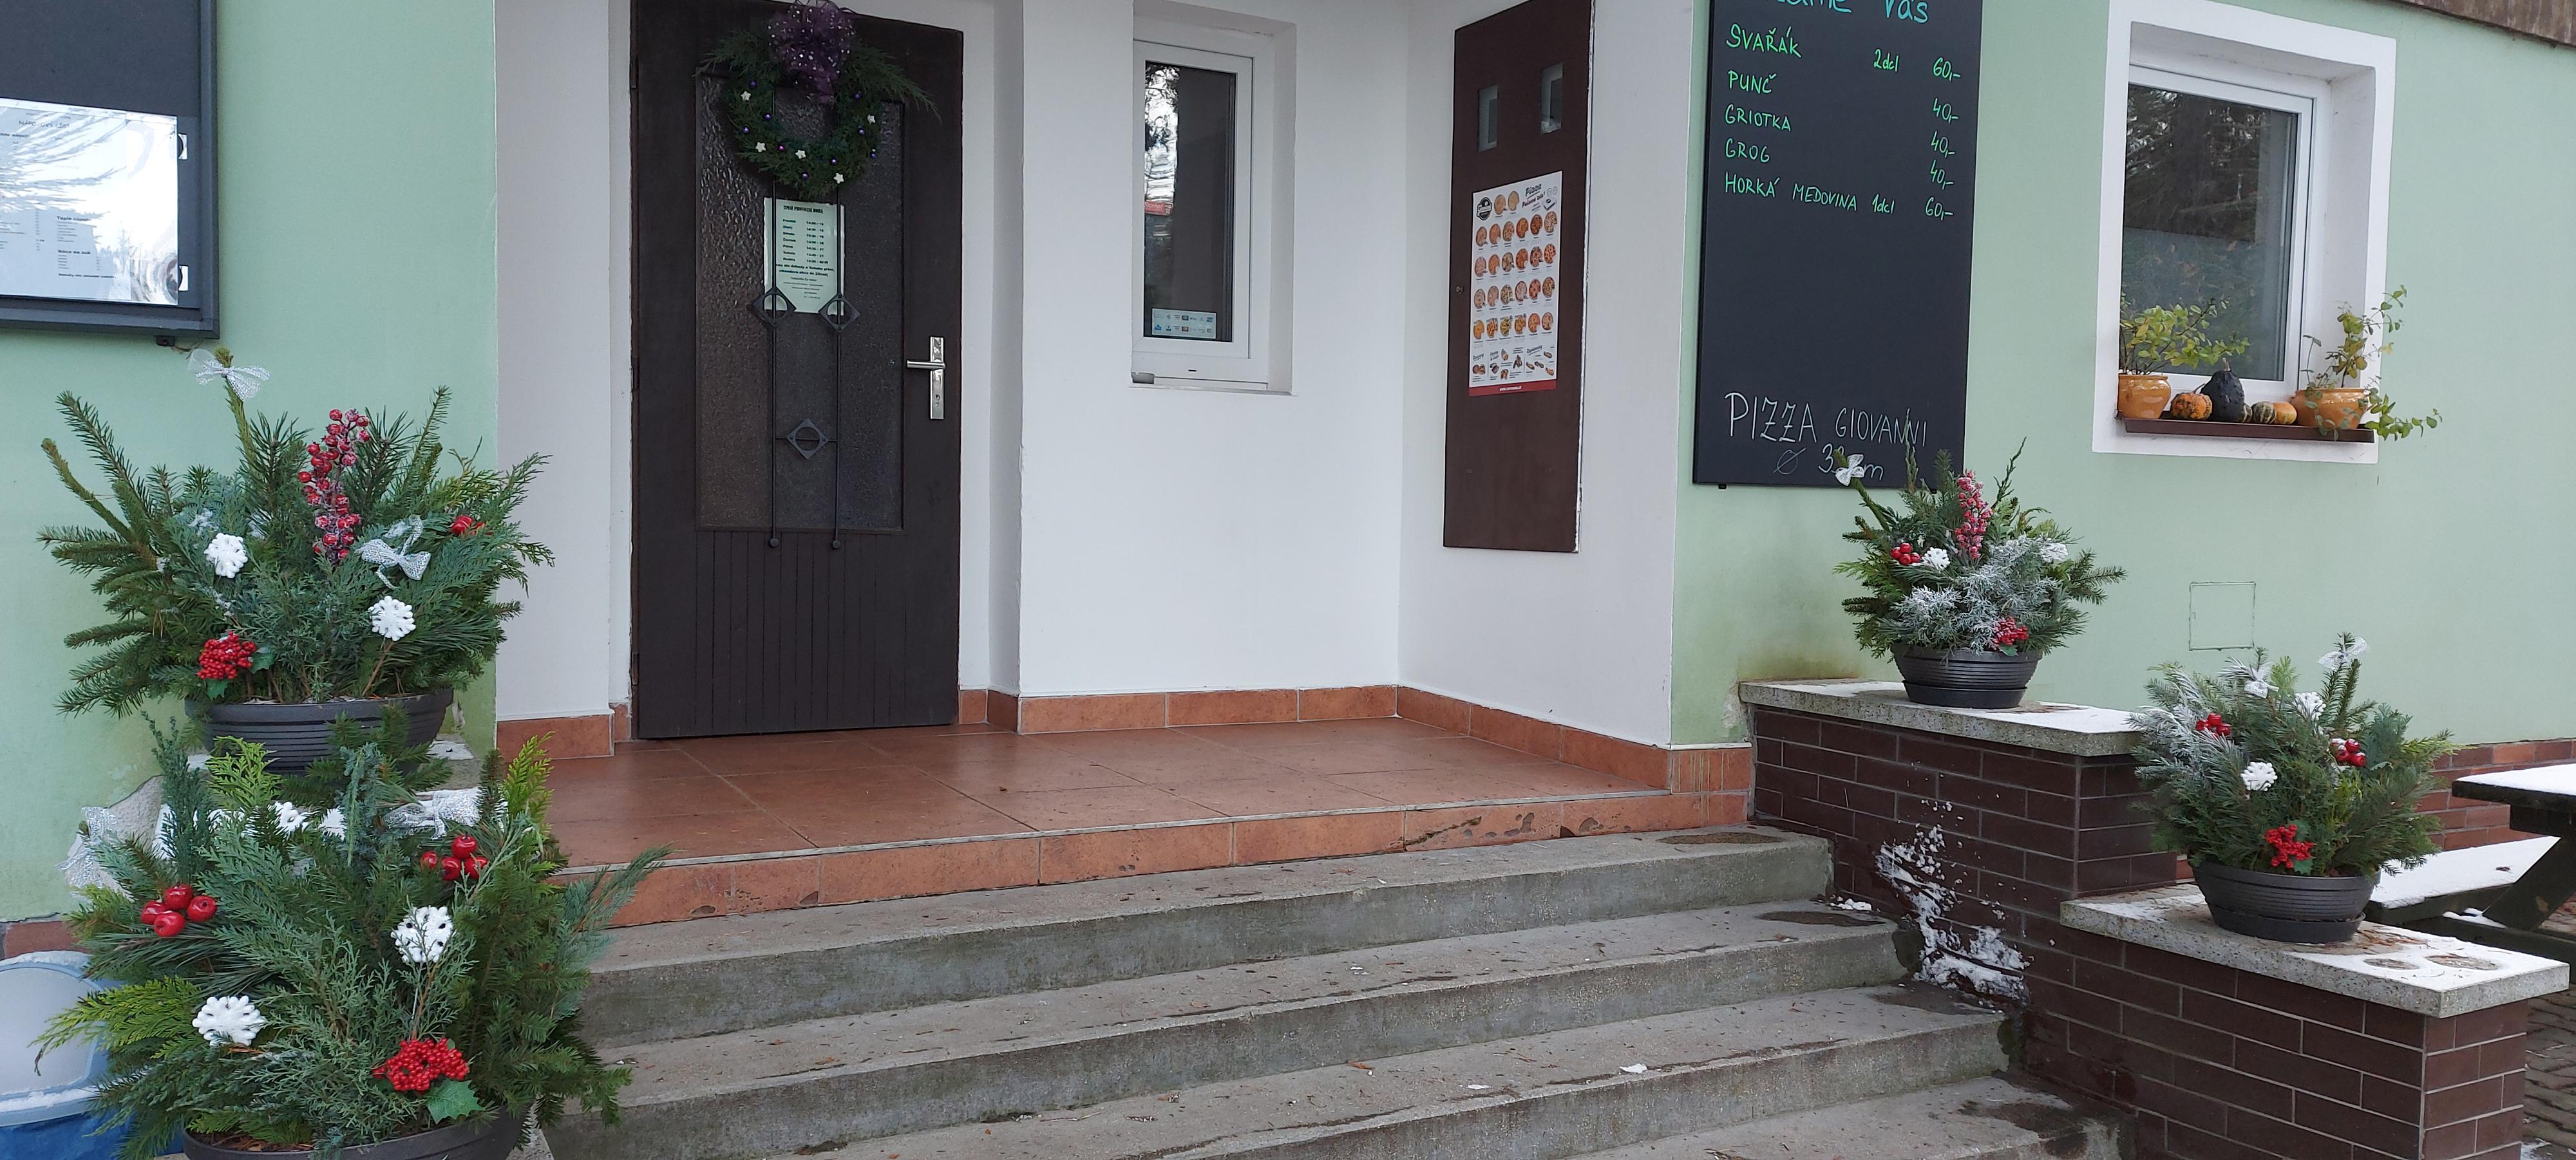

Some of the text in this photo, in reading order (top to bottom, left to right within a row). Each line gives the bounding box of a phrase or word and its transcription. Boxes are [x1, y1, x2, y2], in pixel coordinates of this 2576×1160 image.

[1726, 23, 1961, 82] SVAŘÁK 2dcl 60,-
[1728, 70, 1959, 124] PUNČ 40,-
[1725, 104, 1955, 158] GRIOTKA 40,-
[1725, 138, 1954, 190] GROG 40,-
[1725, 171, 1953, 221] HORKÁ MEDOVINA 1dcl 60,-
[1724, 392, 1927, 447] PIZZA GIOVANNI
